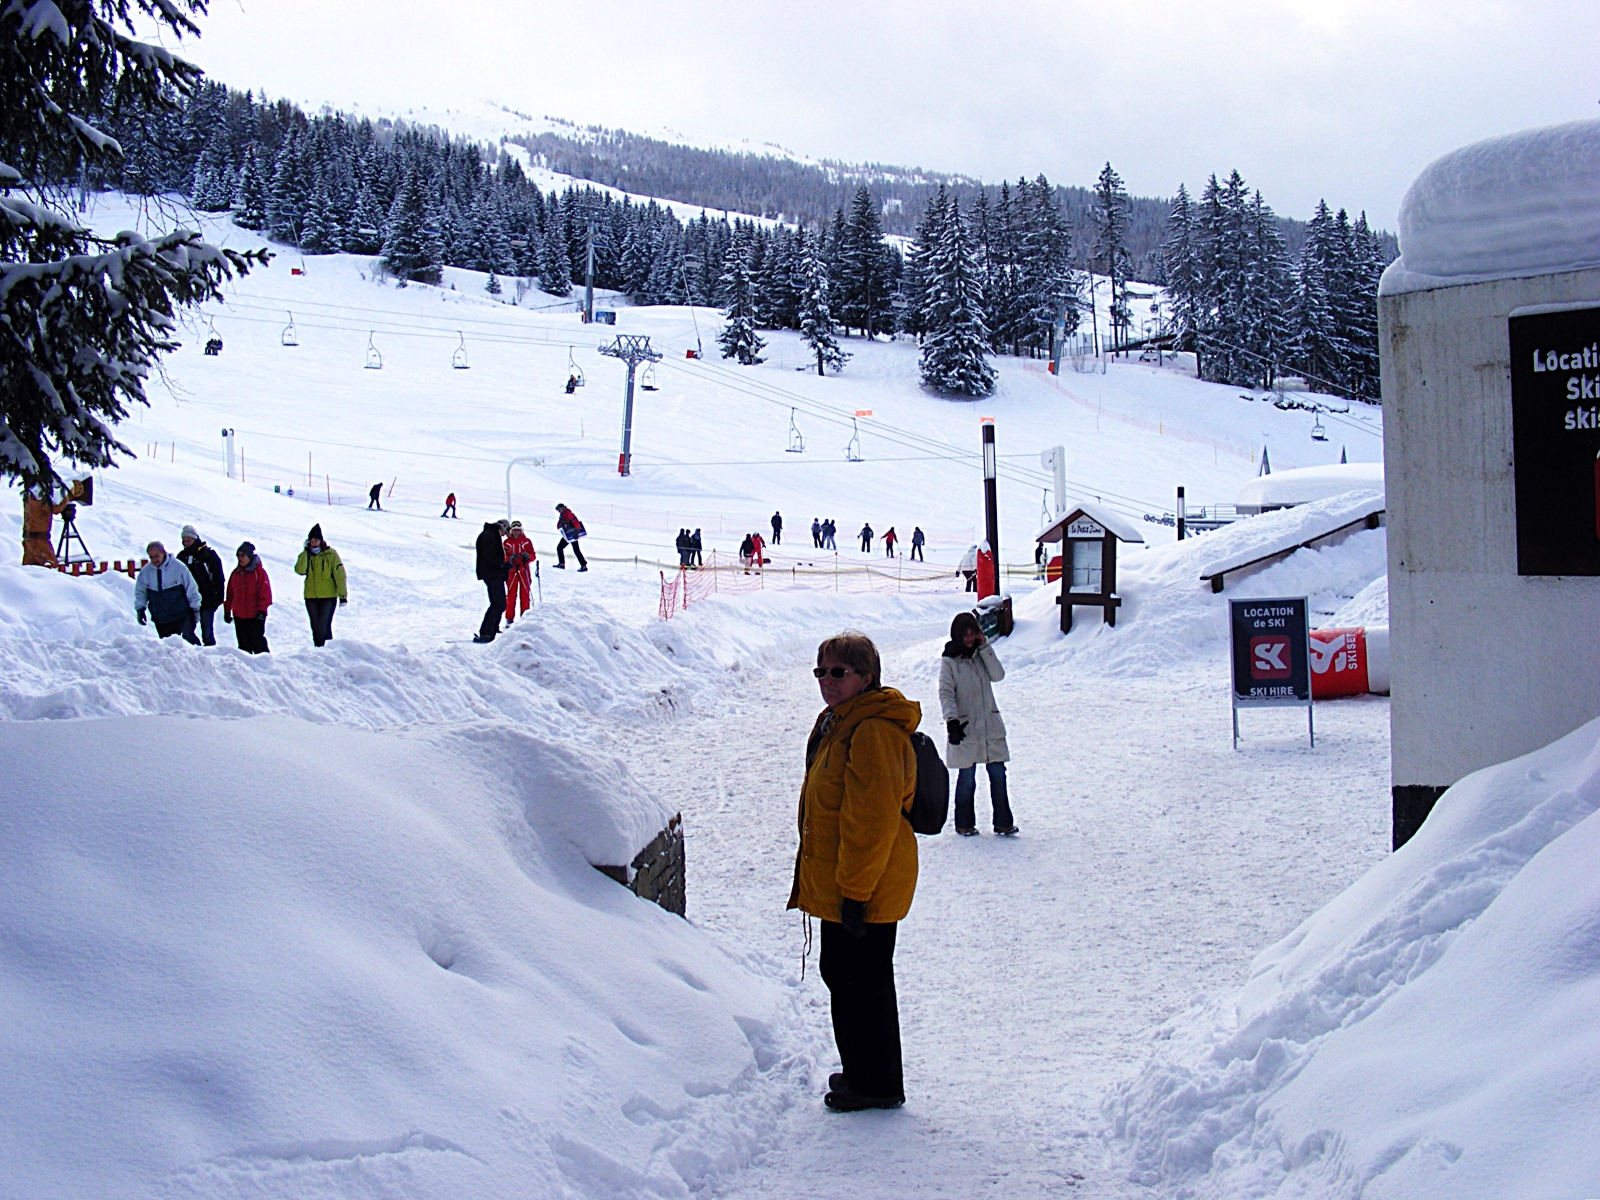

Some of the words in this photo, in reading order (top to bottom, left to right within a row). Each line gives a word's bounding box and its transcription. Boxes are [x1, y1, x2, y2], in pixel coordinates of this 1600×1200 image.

[1533, 342, 1600, 372] Locati
[1566, 373, 1600, 400] Ski
[1564, 405, 1600, 430] ski
[1243, 607, 1294, 617] LOCATION
[1253, 620, 1266, 628] de
[1268, 618, 1285, 627] SKI
[1254, 643, 1288, 671] SK
[1346, 633, 1358, 670] SKISET
[1250, 687, 1267, 696] SKI
[1269, 686, 1294, 695] HIRE
